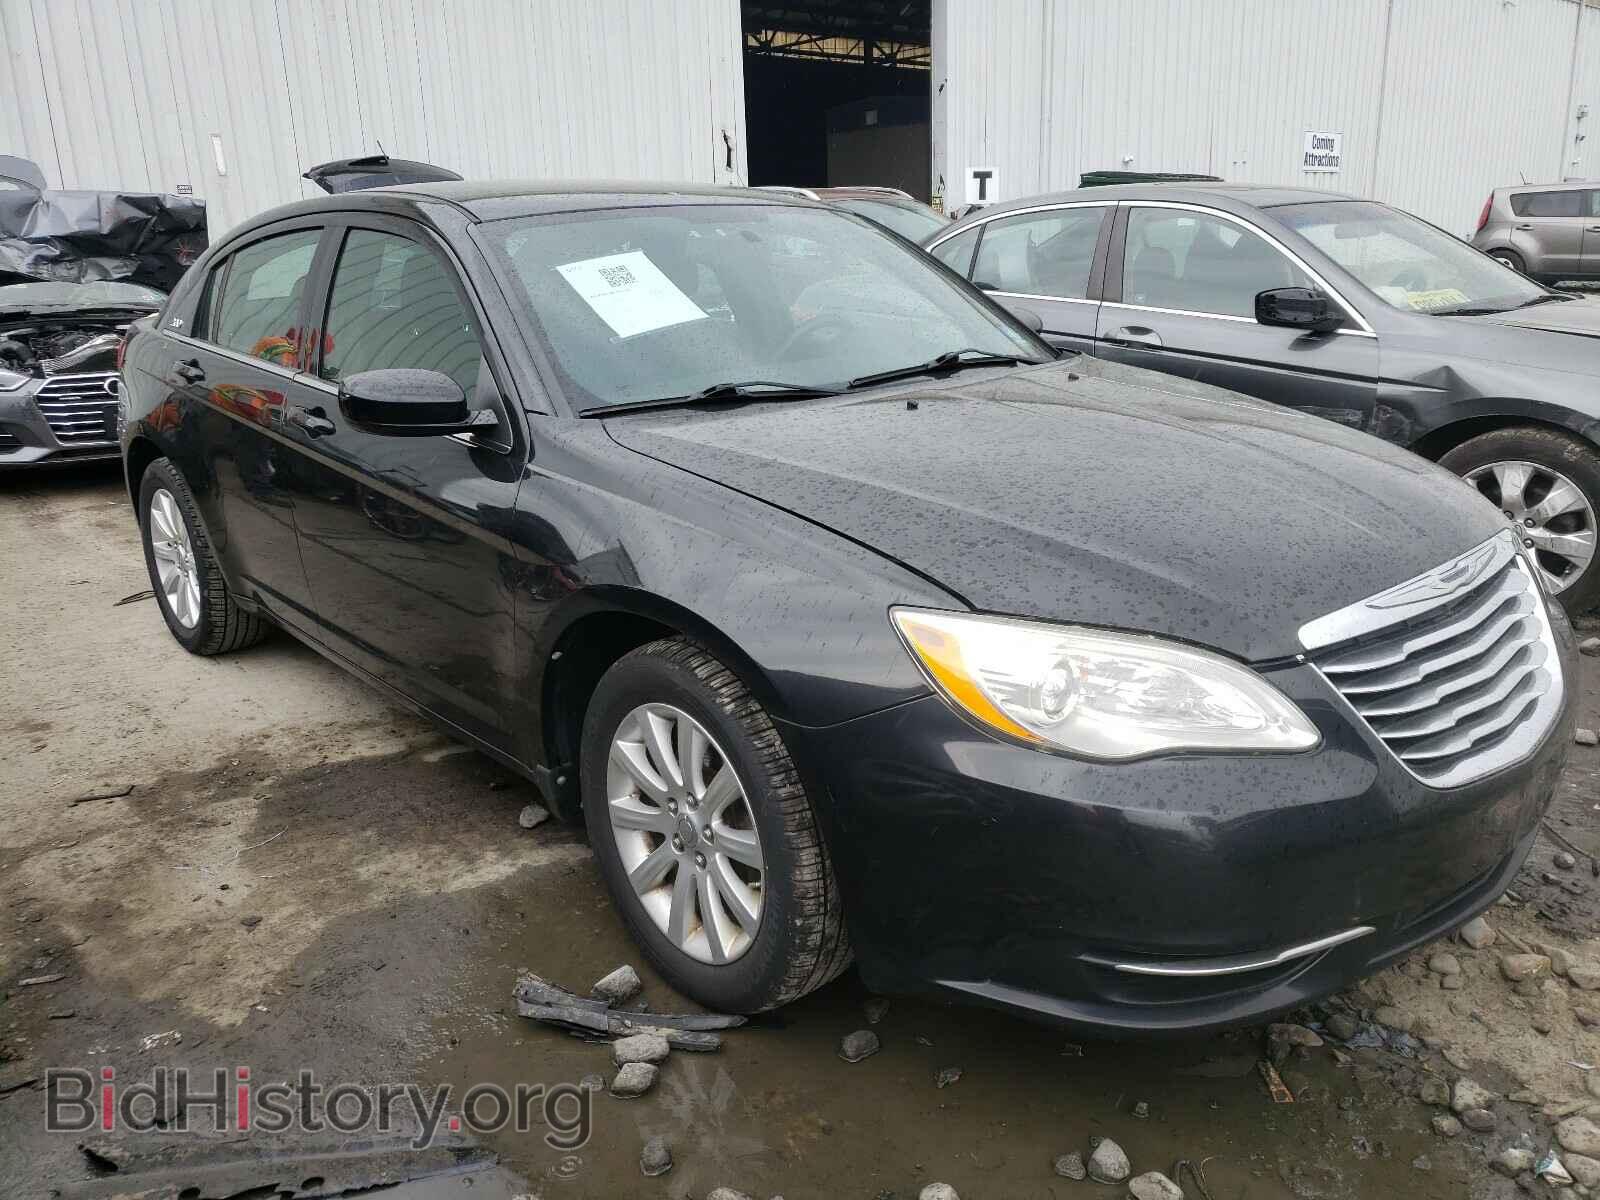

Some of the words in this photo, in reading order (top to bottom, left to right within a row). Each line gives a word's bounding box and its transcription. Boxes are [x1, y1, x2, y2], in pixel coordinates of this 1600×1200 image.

[1312, 134, 1335, 152] Coming
[1303, 152, 1340, 167] Attractions
[973, 171, 992, 200] T
